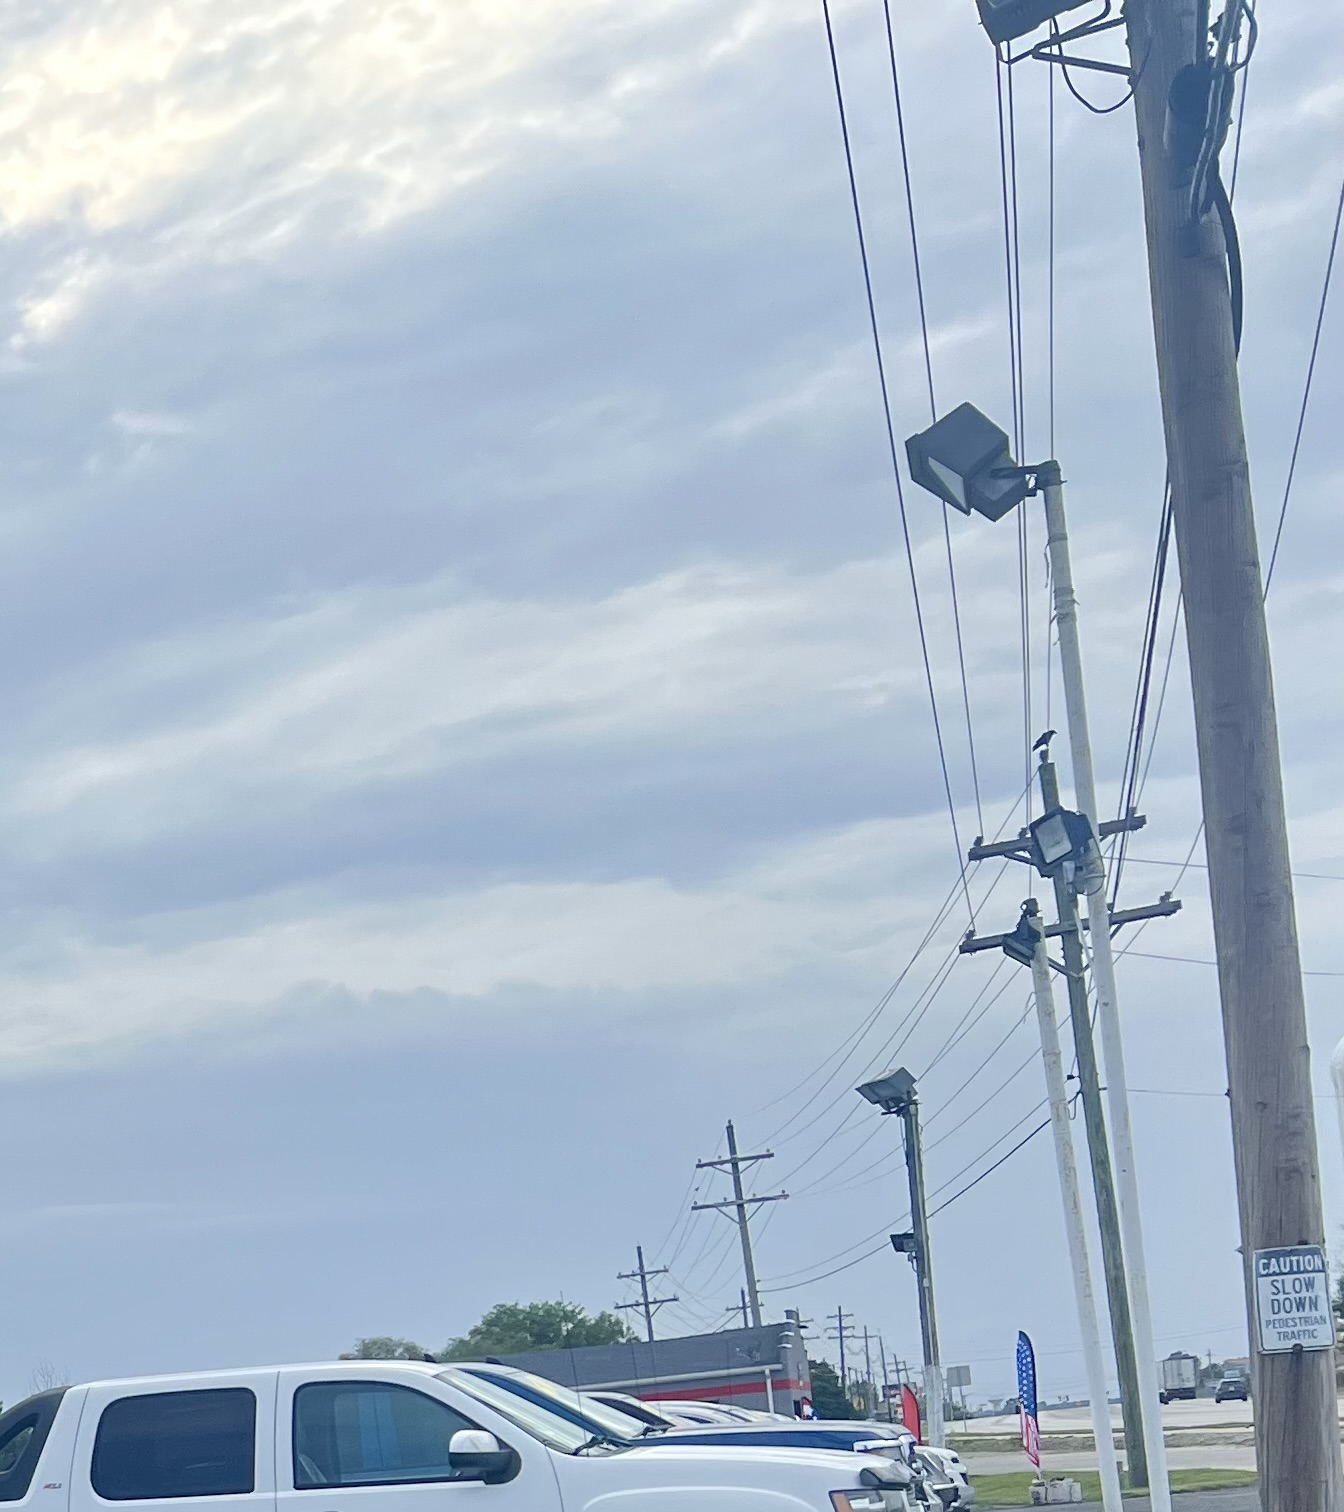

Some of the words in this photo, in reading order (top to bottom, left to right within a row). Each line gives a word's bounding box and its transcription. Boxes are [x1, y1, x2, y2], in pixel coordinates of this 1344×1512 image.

[1259, 1254, 1323, 1275] CAUTION
[1270, 1276, 1316, 1296] SLOW
[1271, 1295, 1319, 1315] DOWN
[1265, 1314, 1327, 1330] PEDESTRIAN
[1276, 1328, 1319, 1342] TRAFFIC
